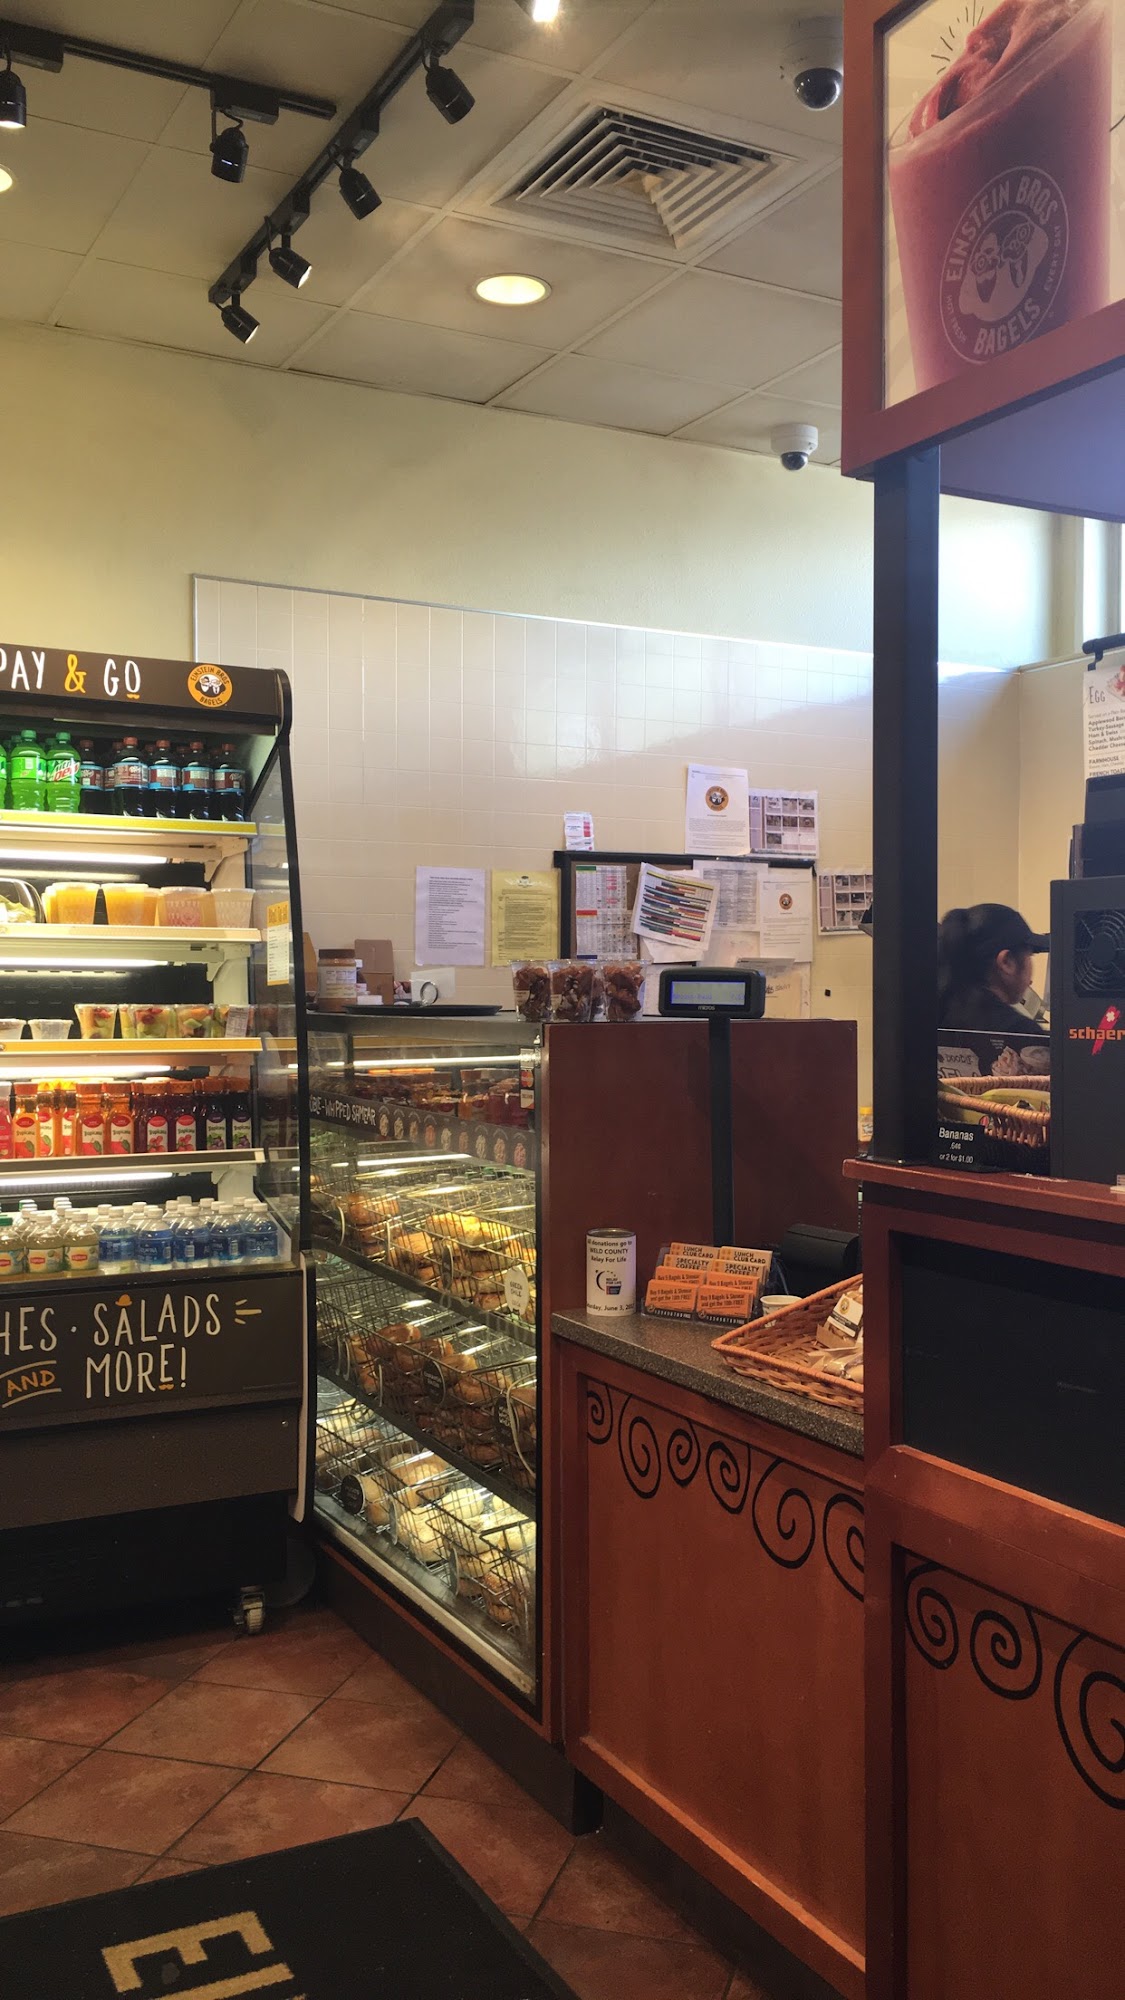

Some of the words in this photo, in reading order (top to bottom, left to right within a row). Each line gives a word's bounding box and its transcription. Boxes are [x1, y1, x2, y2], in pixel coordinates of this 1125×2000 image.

[945, 180, 1010, 282] EINSTEIN
[1016, 176, 1058, 224] BROS
[973, 298, 1041, 355] BAGELS
[64, 654, 87, 693] &
[103, 658, 141, 696] GO
[190, 666, 214, 681] EINSTEIN
[216, 669, 229, 684] BROS
[200, 696, 222, 706] BAGELS
[1088, 718, 1115, 726] Applewood
[1069, 1026, 1125, 1040] schaer
[939, 1127, 974, 1141] Bananas
[958, 1155, 974, 1163] $1.00
[676, 1257, 709, 1266] SPECIALTY
[725, 1263, 759, 1272] SPECIALTY
[93, 1293, 221, 1346] SALADS
[7, 1369, 56, 1398] AND
[86, 1343, 187, 1399] MORE!
